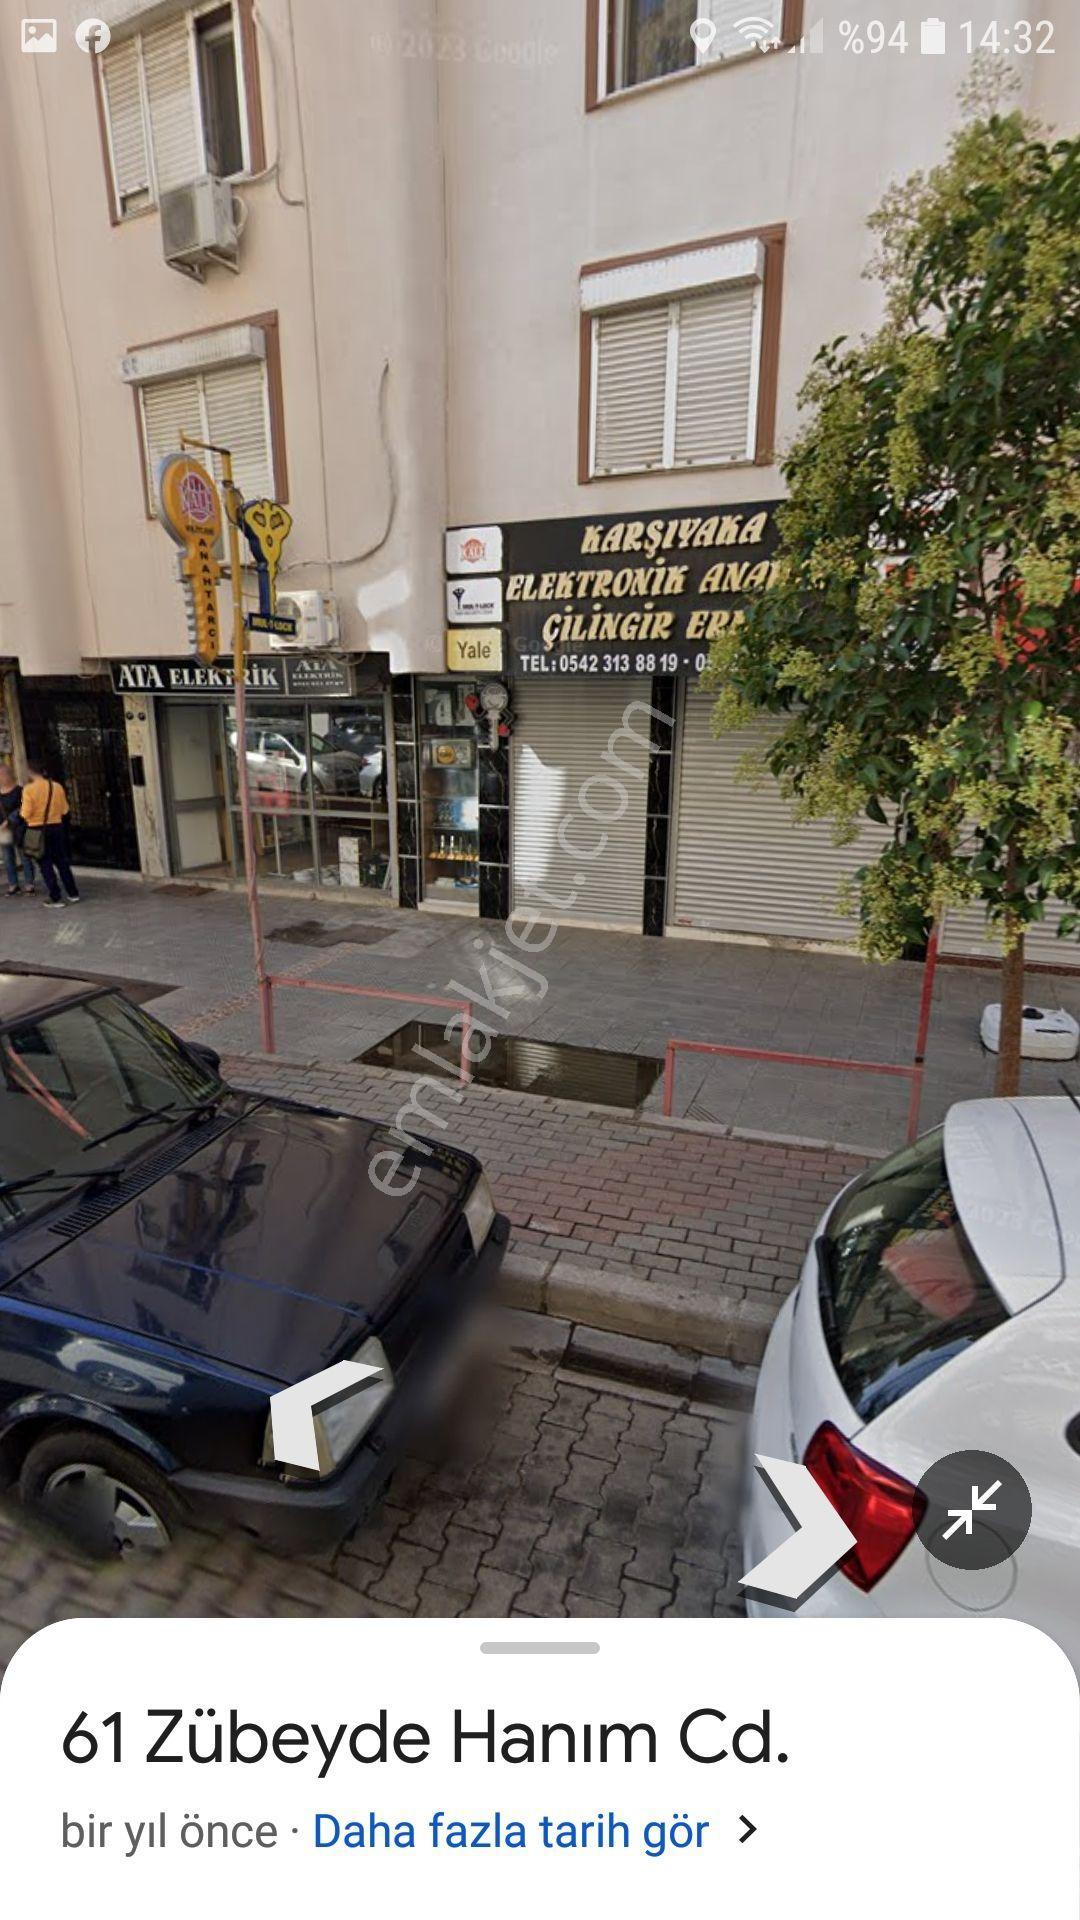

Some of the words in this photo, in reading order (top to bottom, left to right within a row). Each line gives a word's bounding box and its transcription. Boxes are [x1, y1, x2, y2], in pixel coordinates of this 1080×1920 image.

[580, 512, 768, 559] KARŞIYAKA
[199, 537, 216, 650] ANAHTARCI
[505, 556, 690, 602] ELEKTRONİK
[542, 603, 674, 651] ÇİLİNGİR
[457, 641, 492, 660] Yale
[602, 653, 630, 672] 313
[635, 653, 656, 672] 88
[659, 653, 678, 672] 19
[118, 664, 165, 688] ATA
[168, 663, 279, 686] ELEKTRİK
